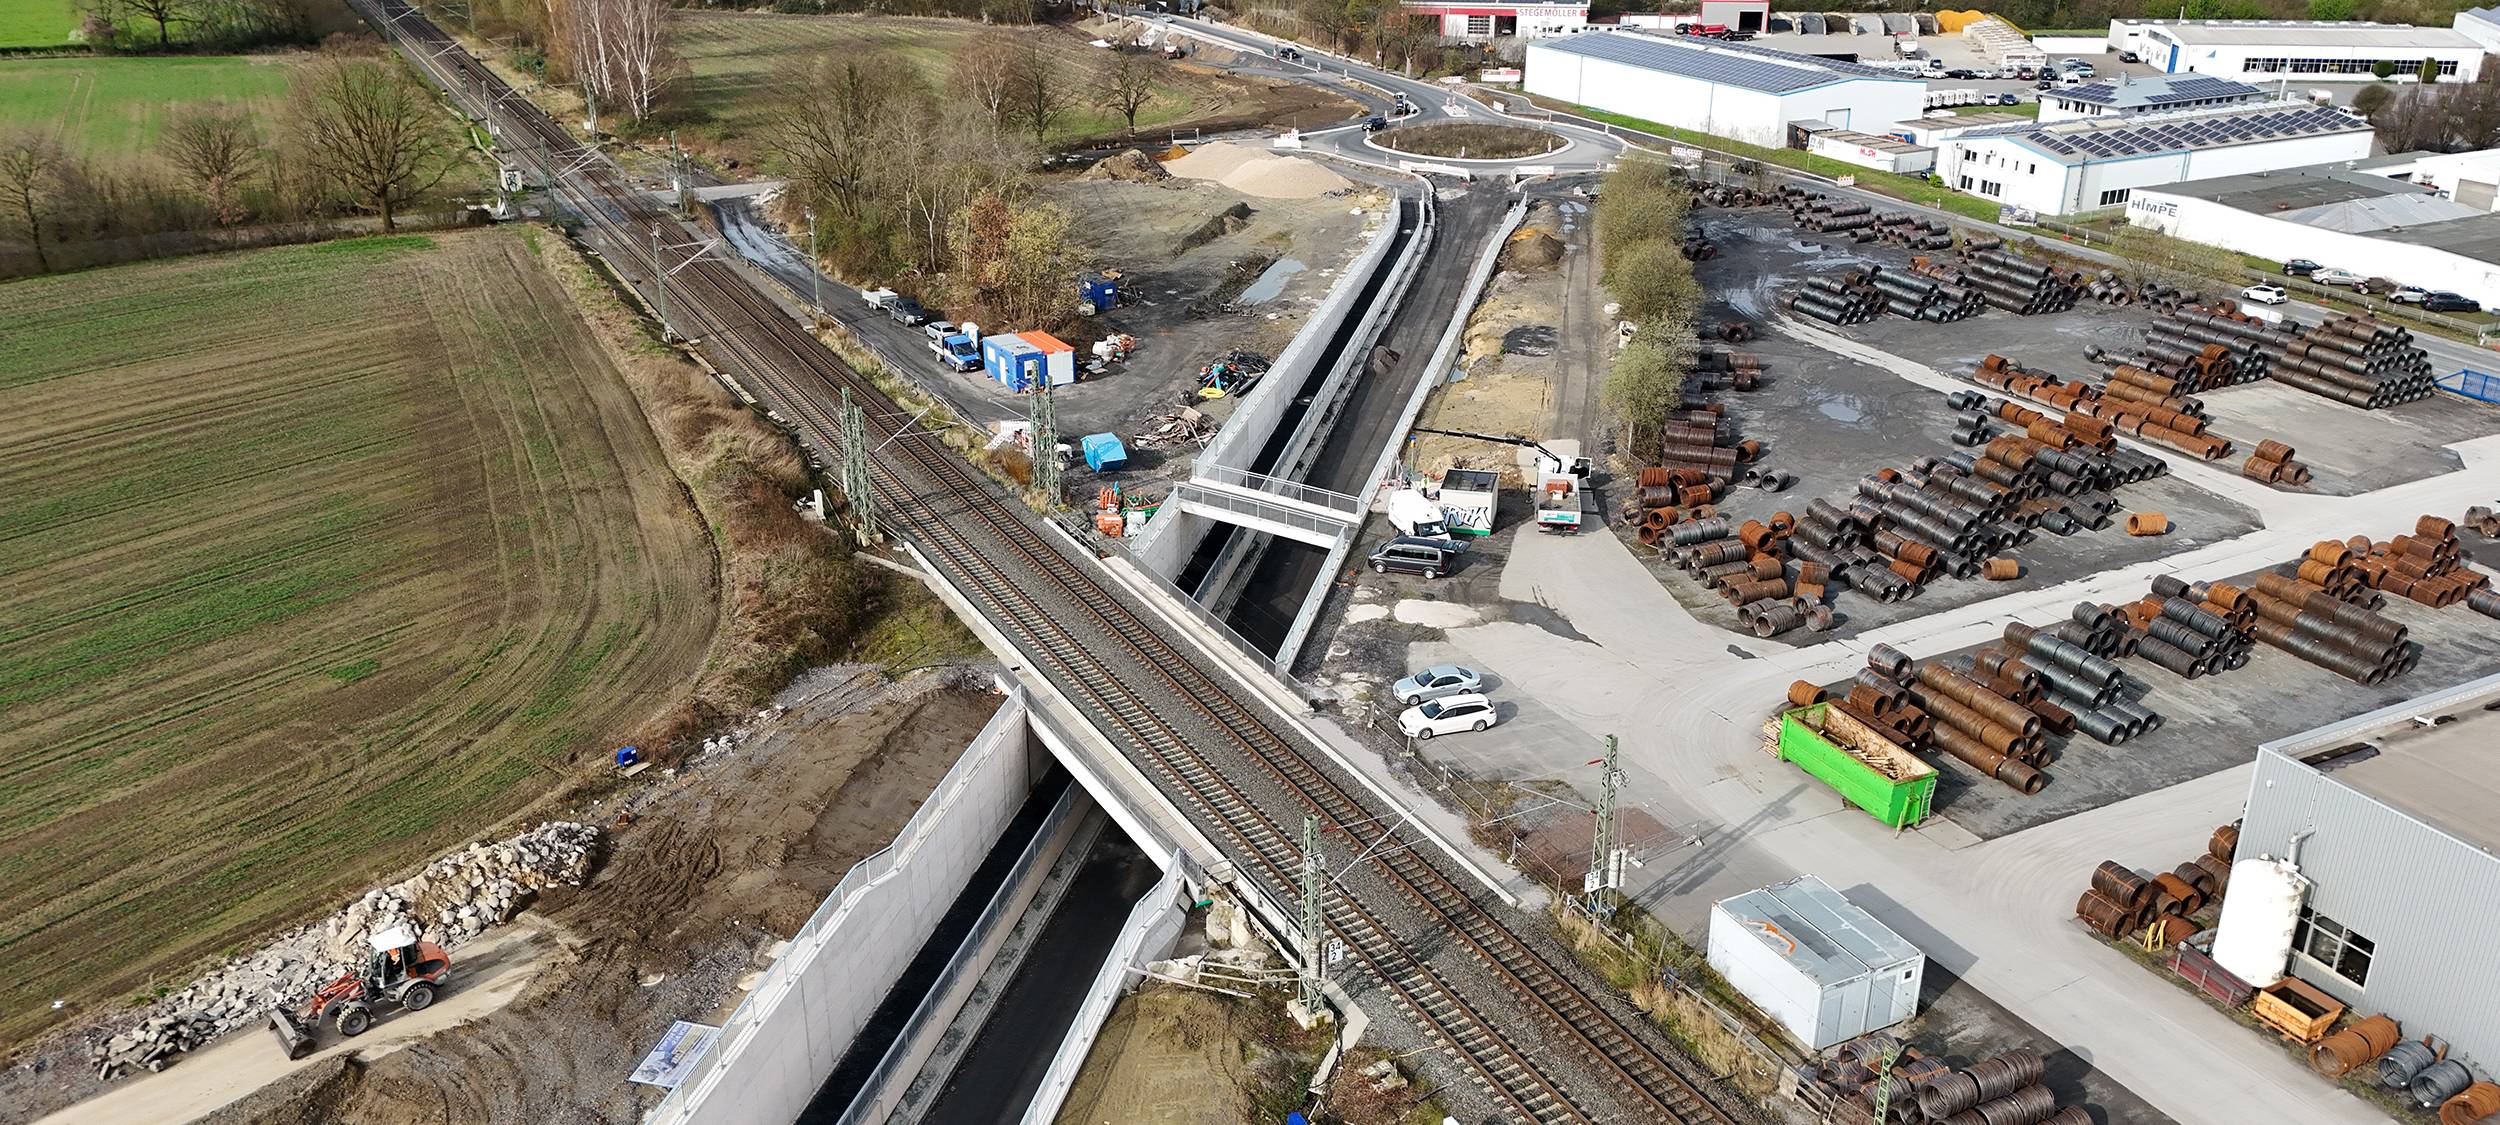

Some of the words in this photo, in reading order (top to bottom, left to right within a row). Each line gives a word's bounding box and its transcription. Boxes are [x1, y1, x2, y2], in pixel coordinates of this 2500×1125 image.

[1519, 8, 1578, 17] STEGEMÖLLER
[2132, 198, 2177, 217] HIMPE
[1590, 880, 1595, 889] 2
[1330, 941, 1341, 952] 34
[1331, 952, 1337, 960] 2
